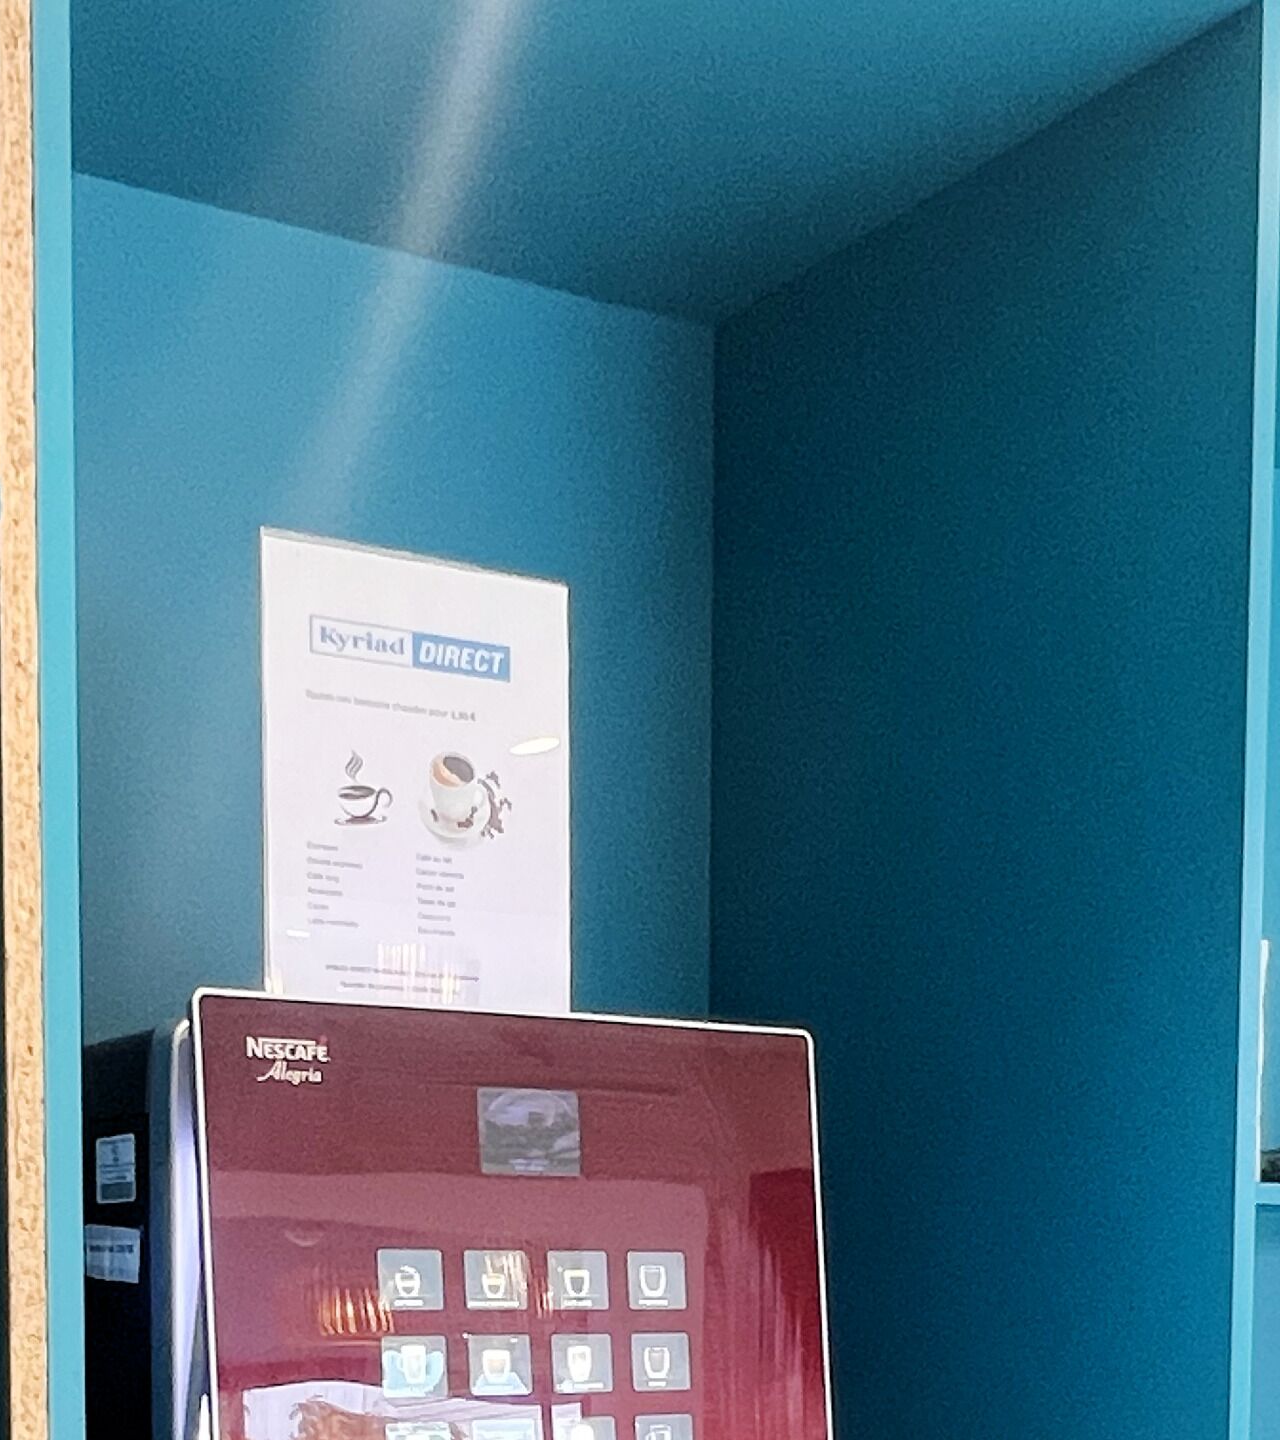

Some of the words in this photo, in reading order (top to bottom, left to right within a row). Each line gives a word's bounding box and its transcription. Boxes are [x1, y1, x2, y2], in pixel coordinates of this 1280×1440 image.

[320, 625, 405, 656] Kyriad
[419, 640, 505, 674] DIRECT
[256, 1060, 322, 1085] Alegria
